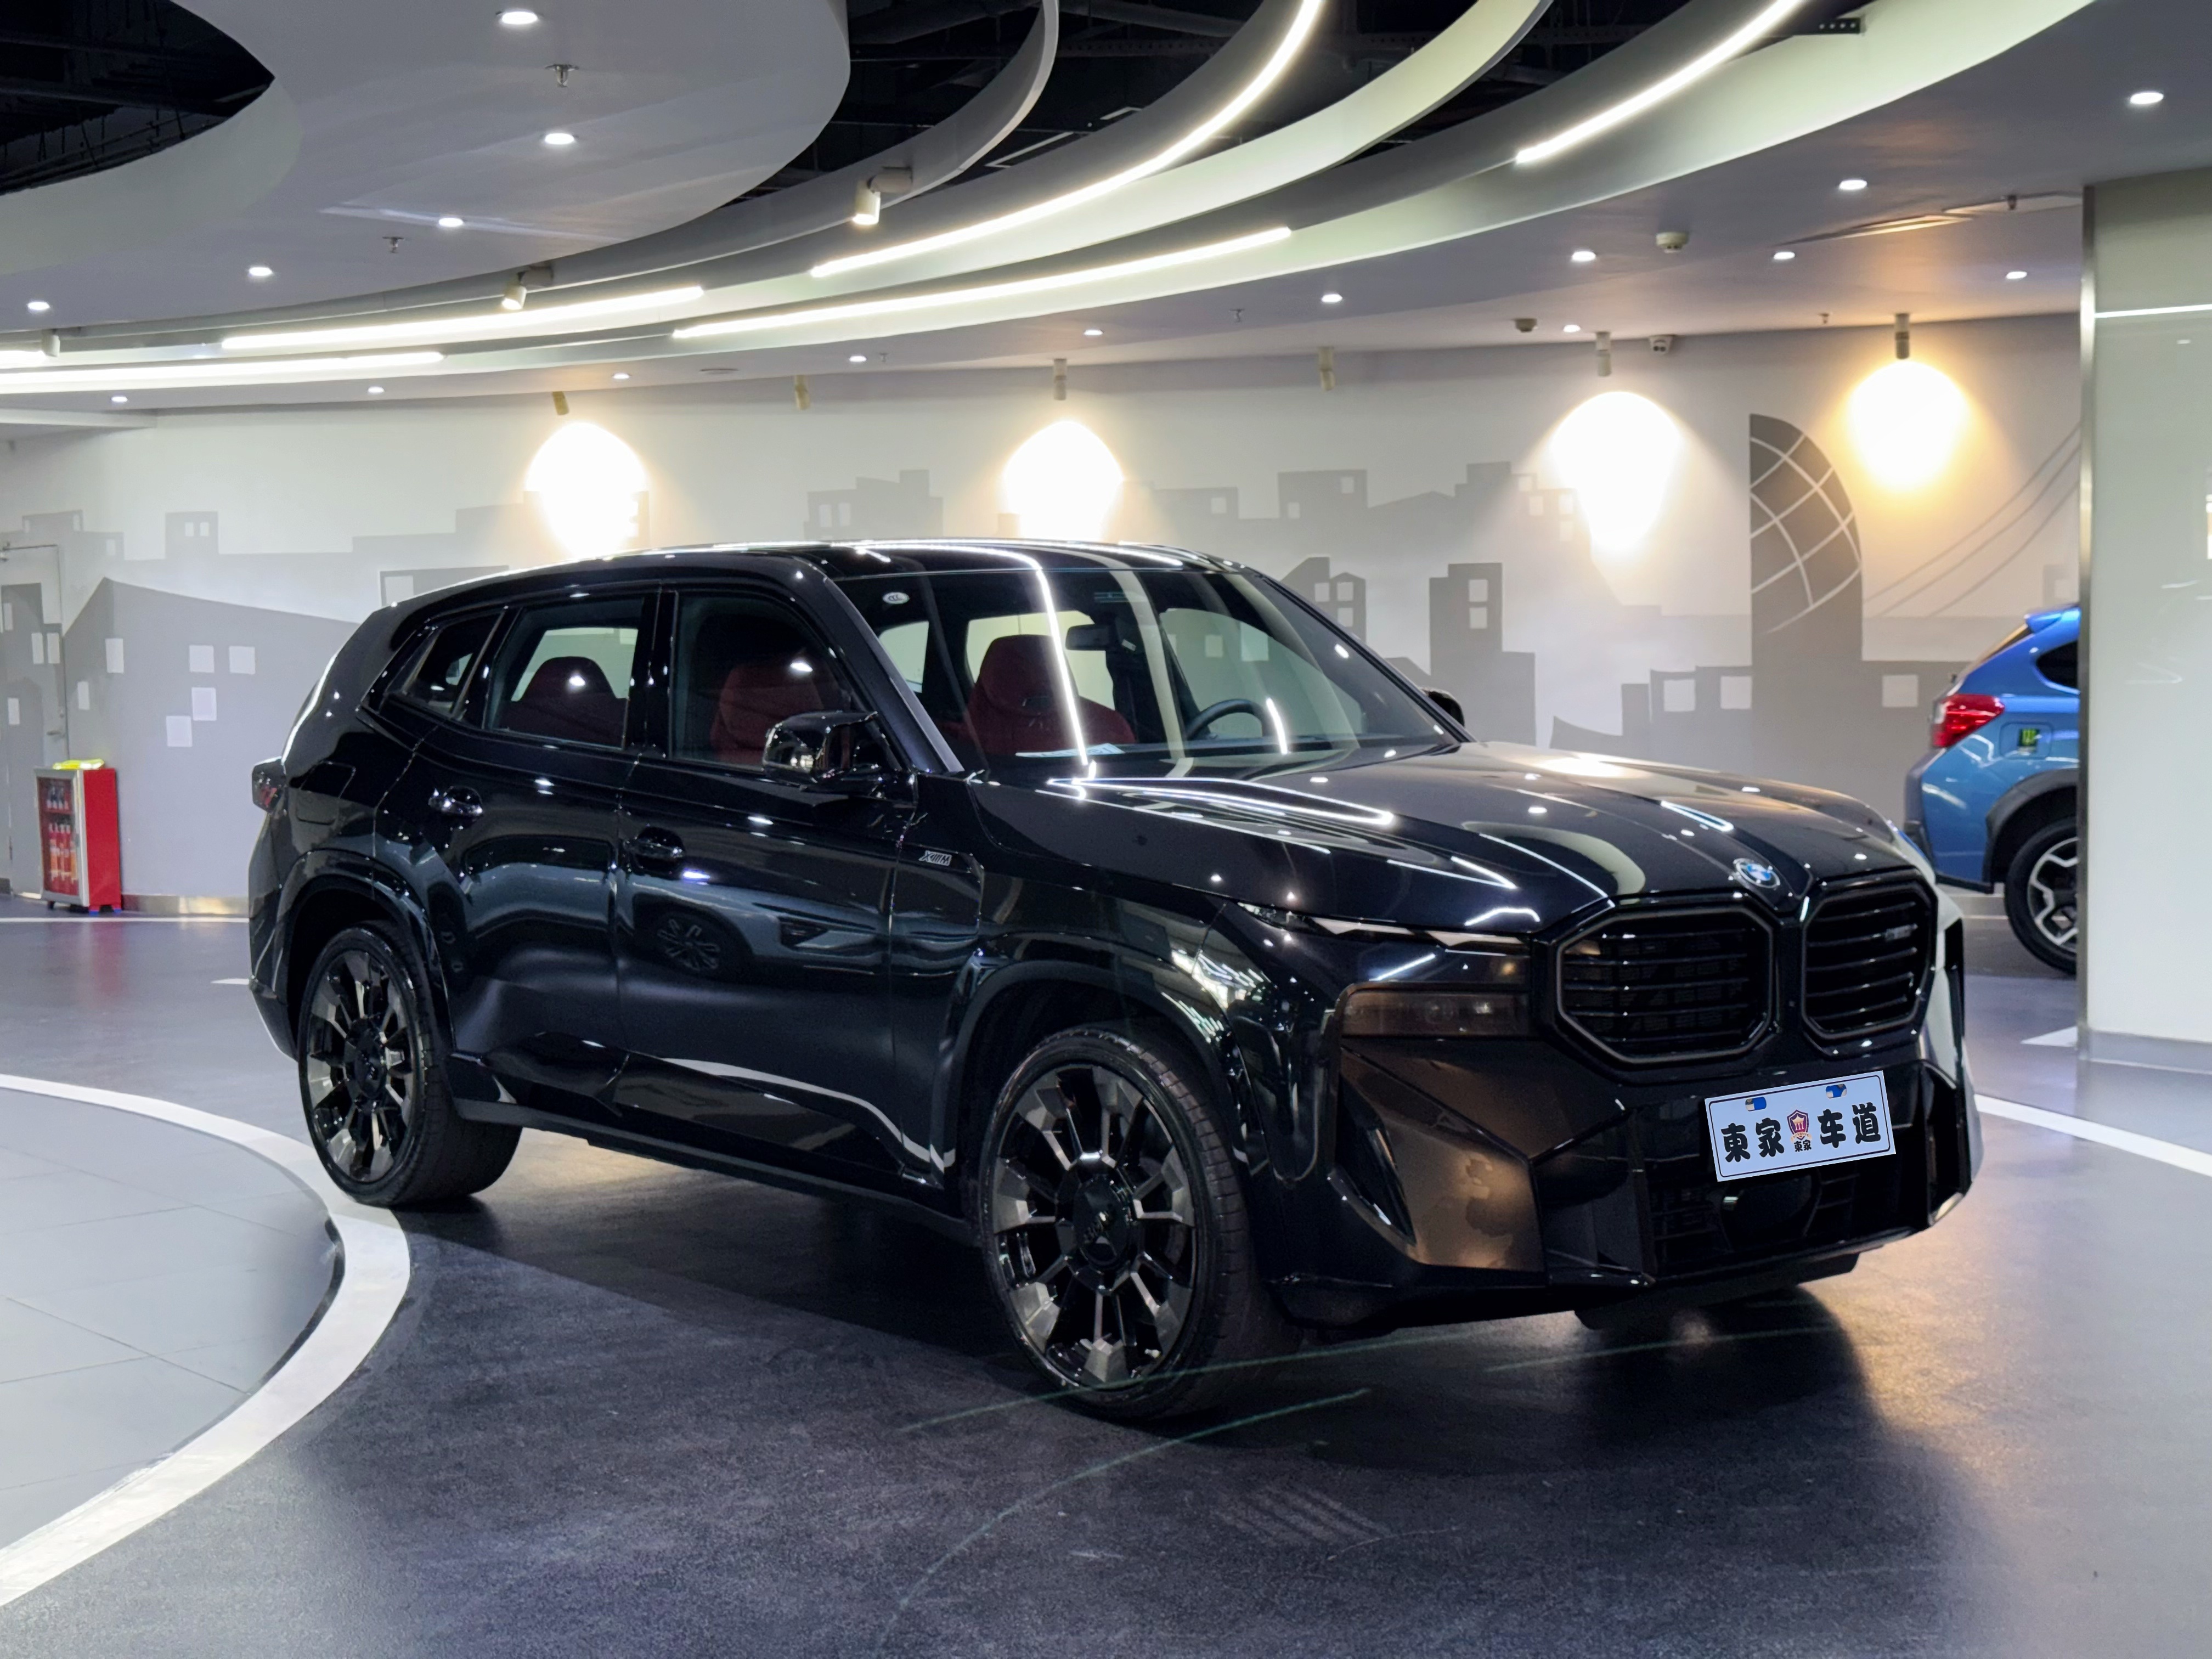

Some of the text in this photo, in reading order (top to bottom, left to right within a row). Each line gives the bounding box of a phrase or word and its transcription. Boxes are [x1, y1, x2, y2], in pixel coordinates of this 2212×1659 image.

[1721, 1102, 1881, 1163] 東家 车道
[1794, 1139, 1812, 1152] 東家
